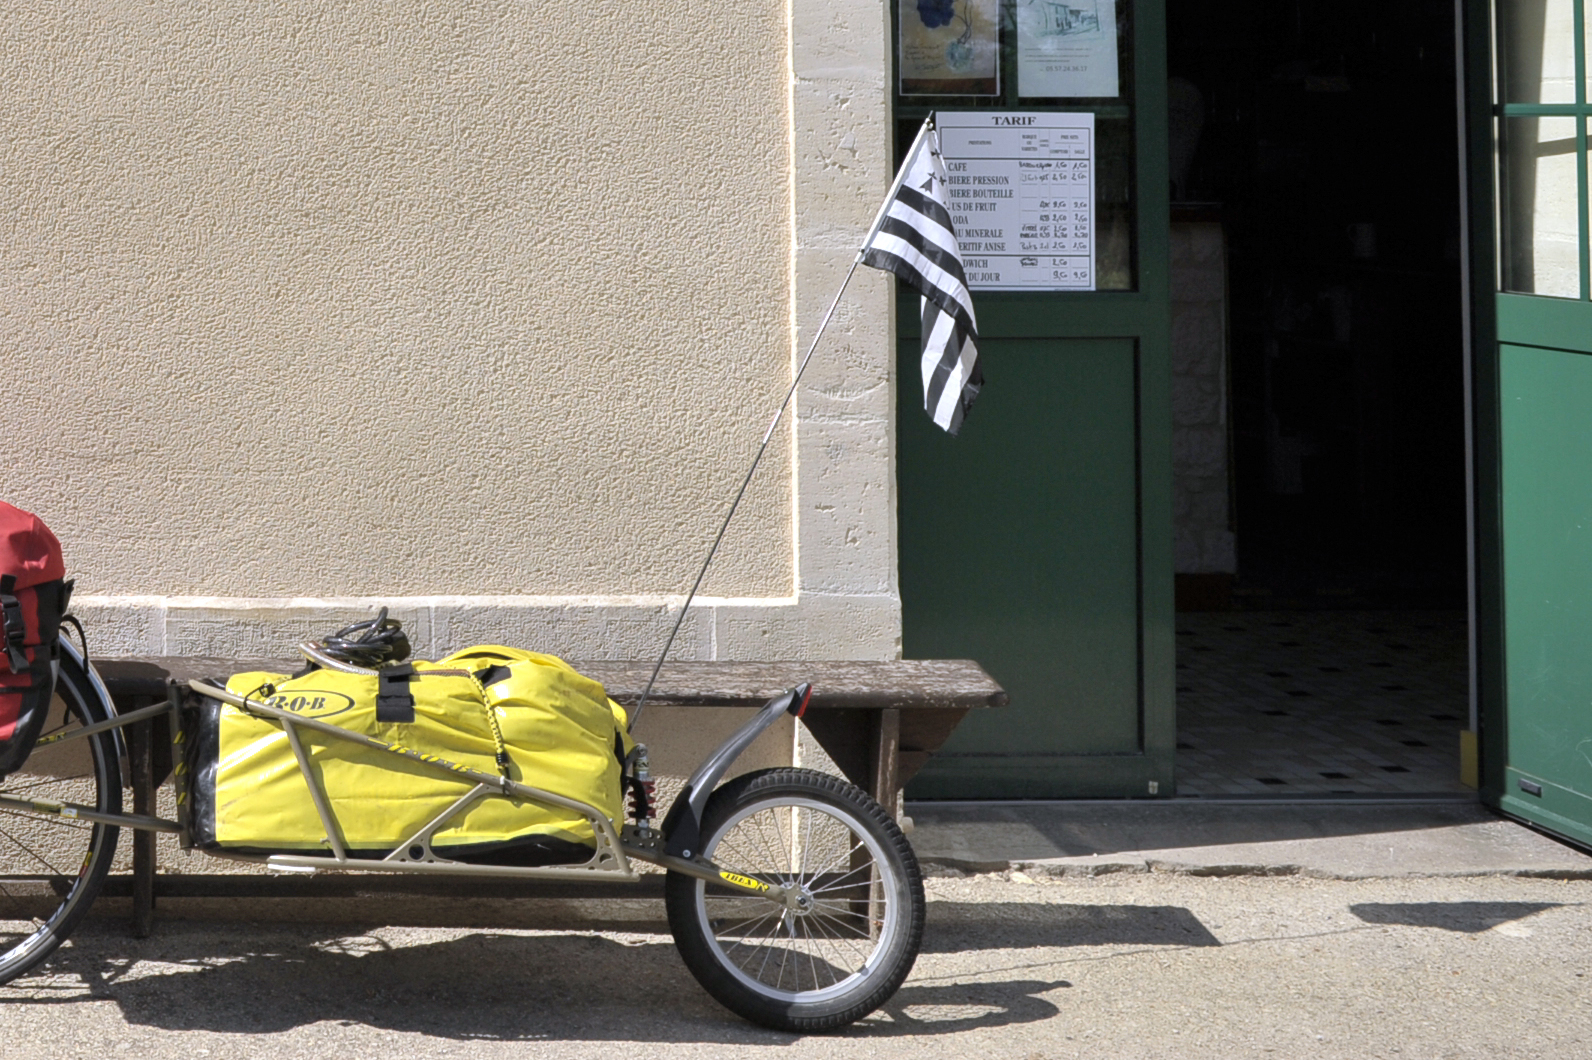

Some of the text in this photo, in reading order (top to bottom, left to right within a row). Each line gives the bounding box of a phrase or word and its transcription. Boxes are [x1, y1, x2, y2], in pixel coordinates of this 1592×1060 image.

[992, 116, 1037, 126] TARIF
[948, 162, 967, 172] CAFE
[948, 176, 1009, 185] BIERE PRESSION
[972, 189, 1014, 198] BOUTEILLE
[951, 202, 997, 211] US DE FRUIT
[953, 216, 969, 225] ODA
[965, 229, 1003, 238] MINERALE
[958, 242, 1006, 251] ERITIF ANISE
[962, 259, 988, 268] DWICH
[969, 273, 979, 282] DU
[980, 273, 1000, 282] JOUR
